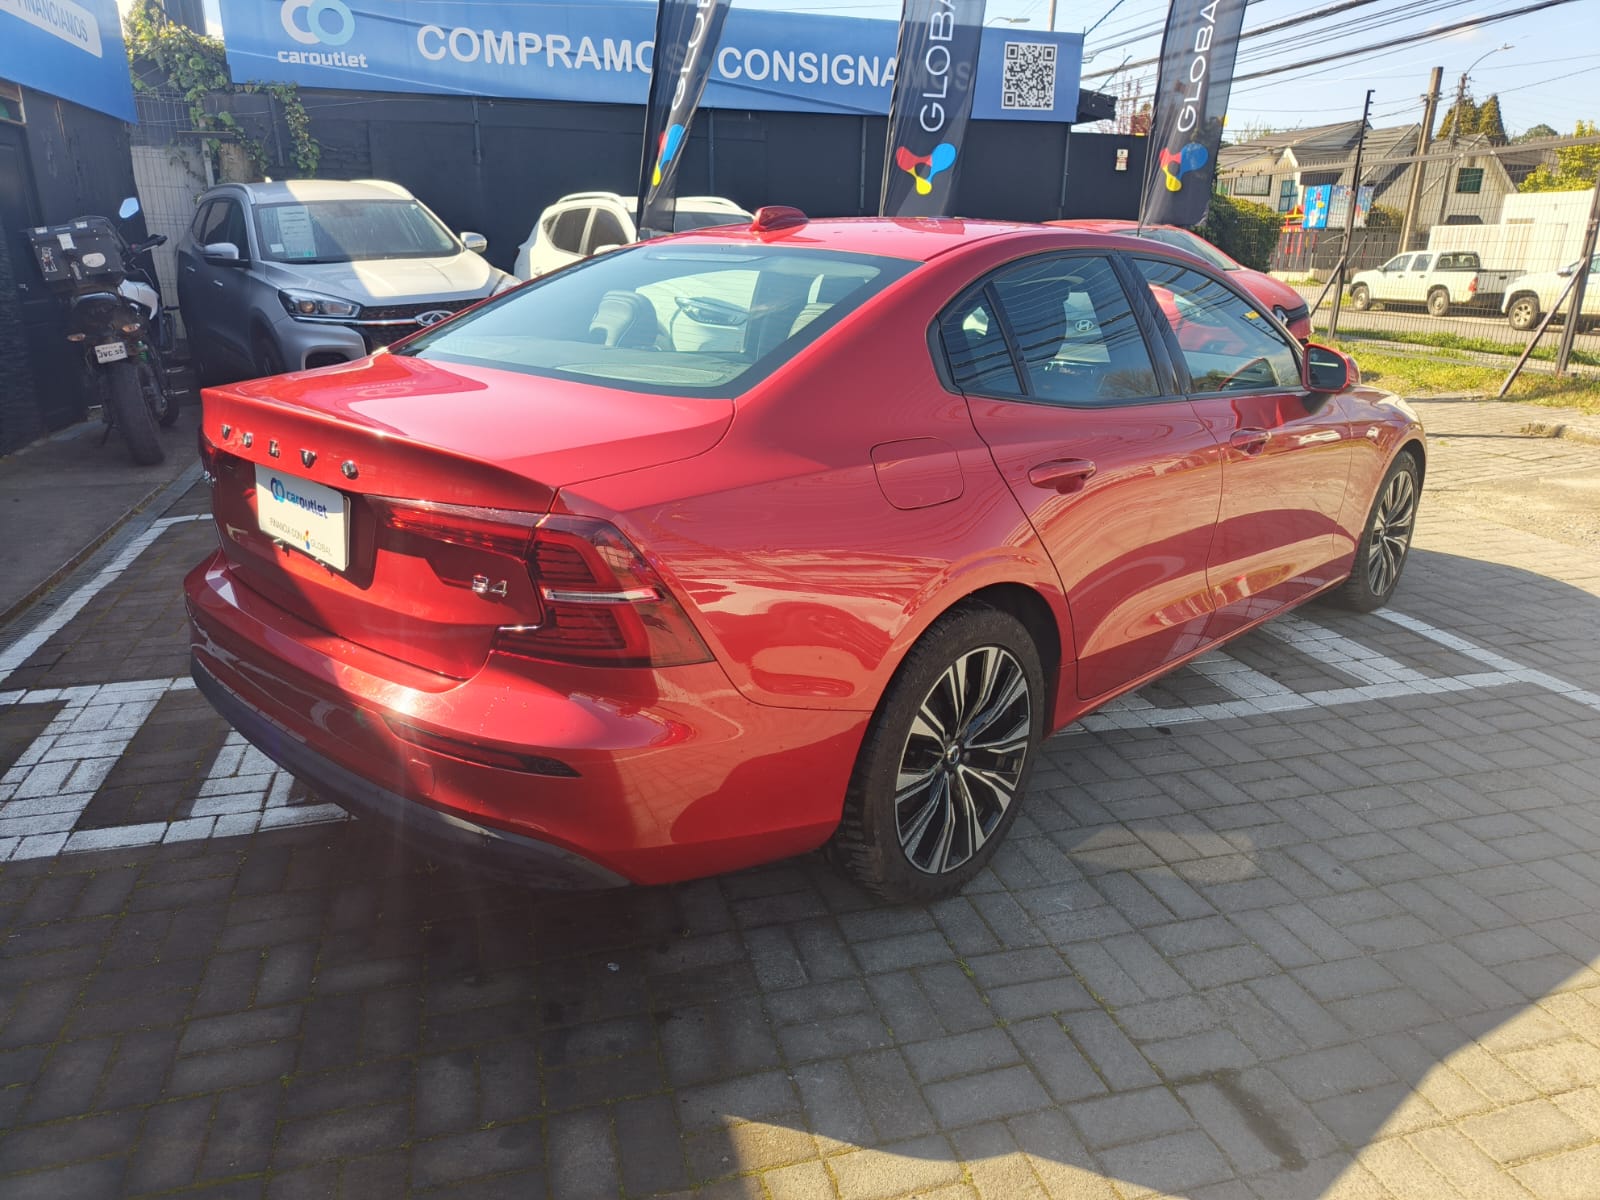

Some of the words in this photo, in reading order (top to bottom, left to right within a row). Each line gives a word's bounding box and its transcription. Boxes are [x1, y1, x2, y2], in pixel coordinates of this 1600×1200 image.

[277, 50, 368, 68] caroutlet
[672, 0, 710, 110] GLO
[221, 423, 360, 480] VOLVO
[286, 490, 328, 519] caroutlet
[472, 574, 507, 598] B4
